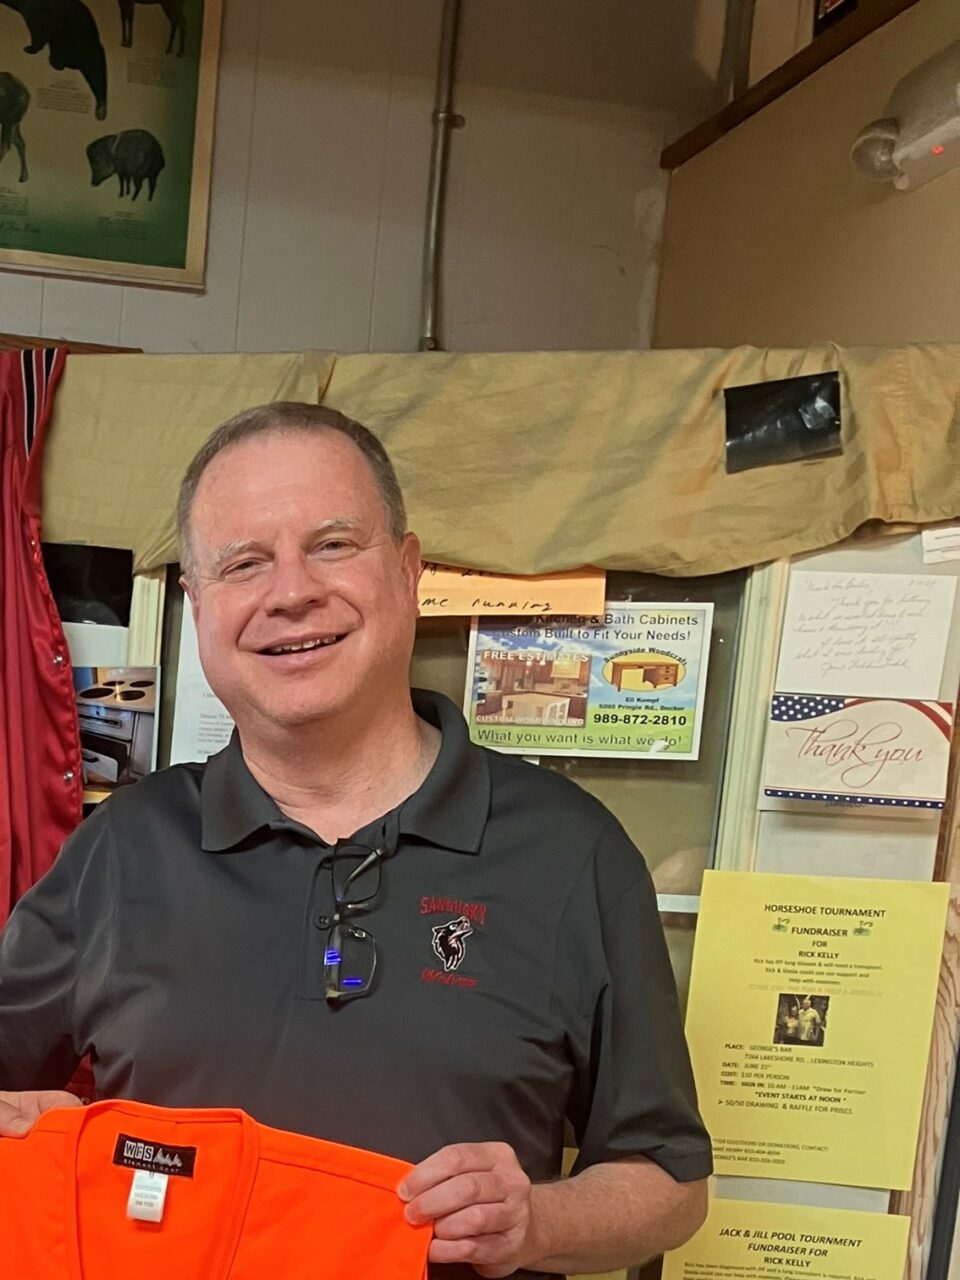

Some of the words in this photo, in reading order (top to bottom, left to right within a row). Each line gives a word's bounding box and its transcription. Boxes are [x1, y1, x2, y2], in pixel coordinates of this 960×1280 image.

[604, 613, 635, 625] Bath
[640, 613, 699, 626] Cabinets
[545, 627, 573, 639] Built
[578, 629, 590, 640] to
[594, 629, 609, 640] Fit
[614, 630, 642, 641] Your
[646, 630, 692, 641] Needs!
[483, 650, 515, 661] FREE
[518, 651, 589, 663] ESTIMATES
[593, 713, 687, 726] 989-872-2810
[477, 728, 512, 741] What
[516, 732, 541, 745] you
[545, 732, 578, 744] want
[582, 733, 594, 744] is
[598, 733, 631, 745] what
[636, 736, 655, 746] we
[785, 719, 903, 767] Thank
[841, 746, 924, 789] you
[764, 904, 818, 915] HORSESHOE
[820, 906, 887, 918] TOURNAMENT
[791, 926, 849, 937] FUNDRAISER
[812, 940, 828, 948] FOR
[798, 950, 815, 958] RICK
[817, 951, 840, 959] KELLY
[123, 1139, 155, 1162] WFS
[719, 1228, 742, 1238] JACK
[743, 1230, 751, 1238] &
[752, 1231, 769, 1239] JILL
[770, 1232, 797, 1242] POOL
[799, 1234, 863, 1248] TOURNMENT
[747, 1243, 807, 1255] FUNDRAISER
[808, 1248, 829, 1257] FOR
[763, 1256, 783, 1265] RICK
[785, 1258, 812, 1268] KELLY
